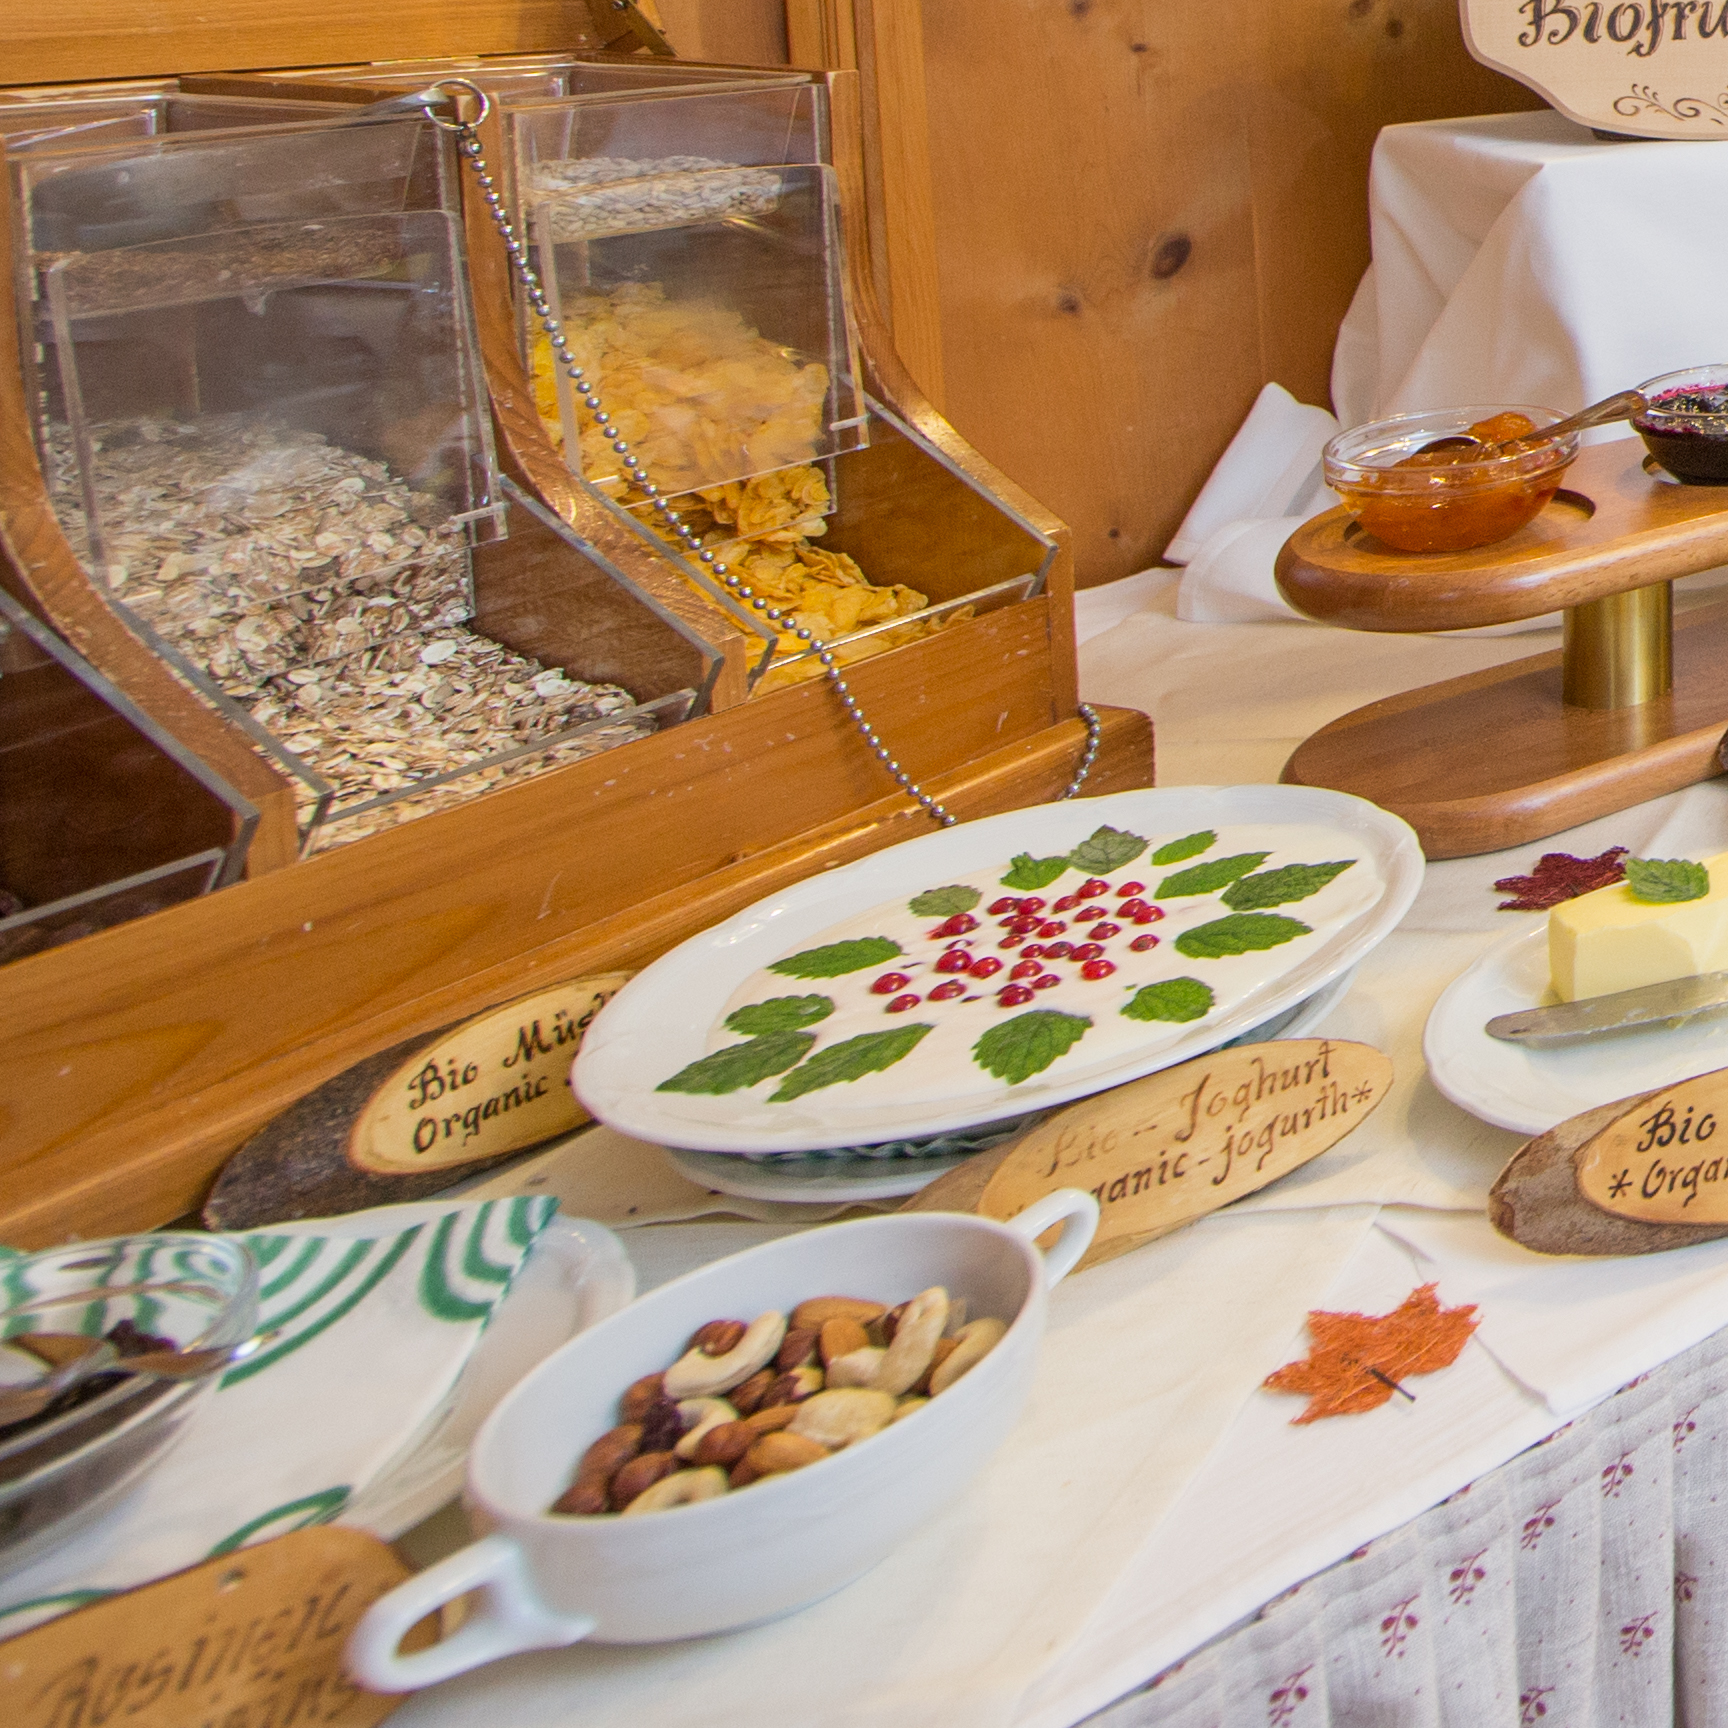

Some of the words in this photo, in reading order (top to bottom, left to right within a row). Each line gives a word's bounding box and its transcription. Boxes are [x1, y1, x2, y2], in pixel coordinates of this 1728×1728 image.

[406, 1057, 480, 1111] Bio
[412, 1073, 549, 1154] Organic
[1174, 1041, 1339, 1145] Joghurt
[1636, 1099, 1717, 1154] Bio
